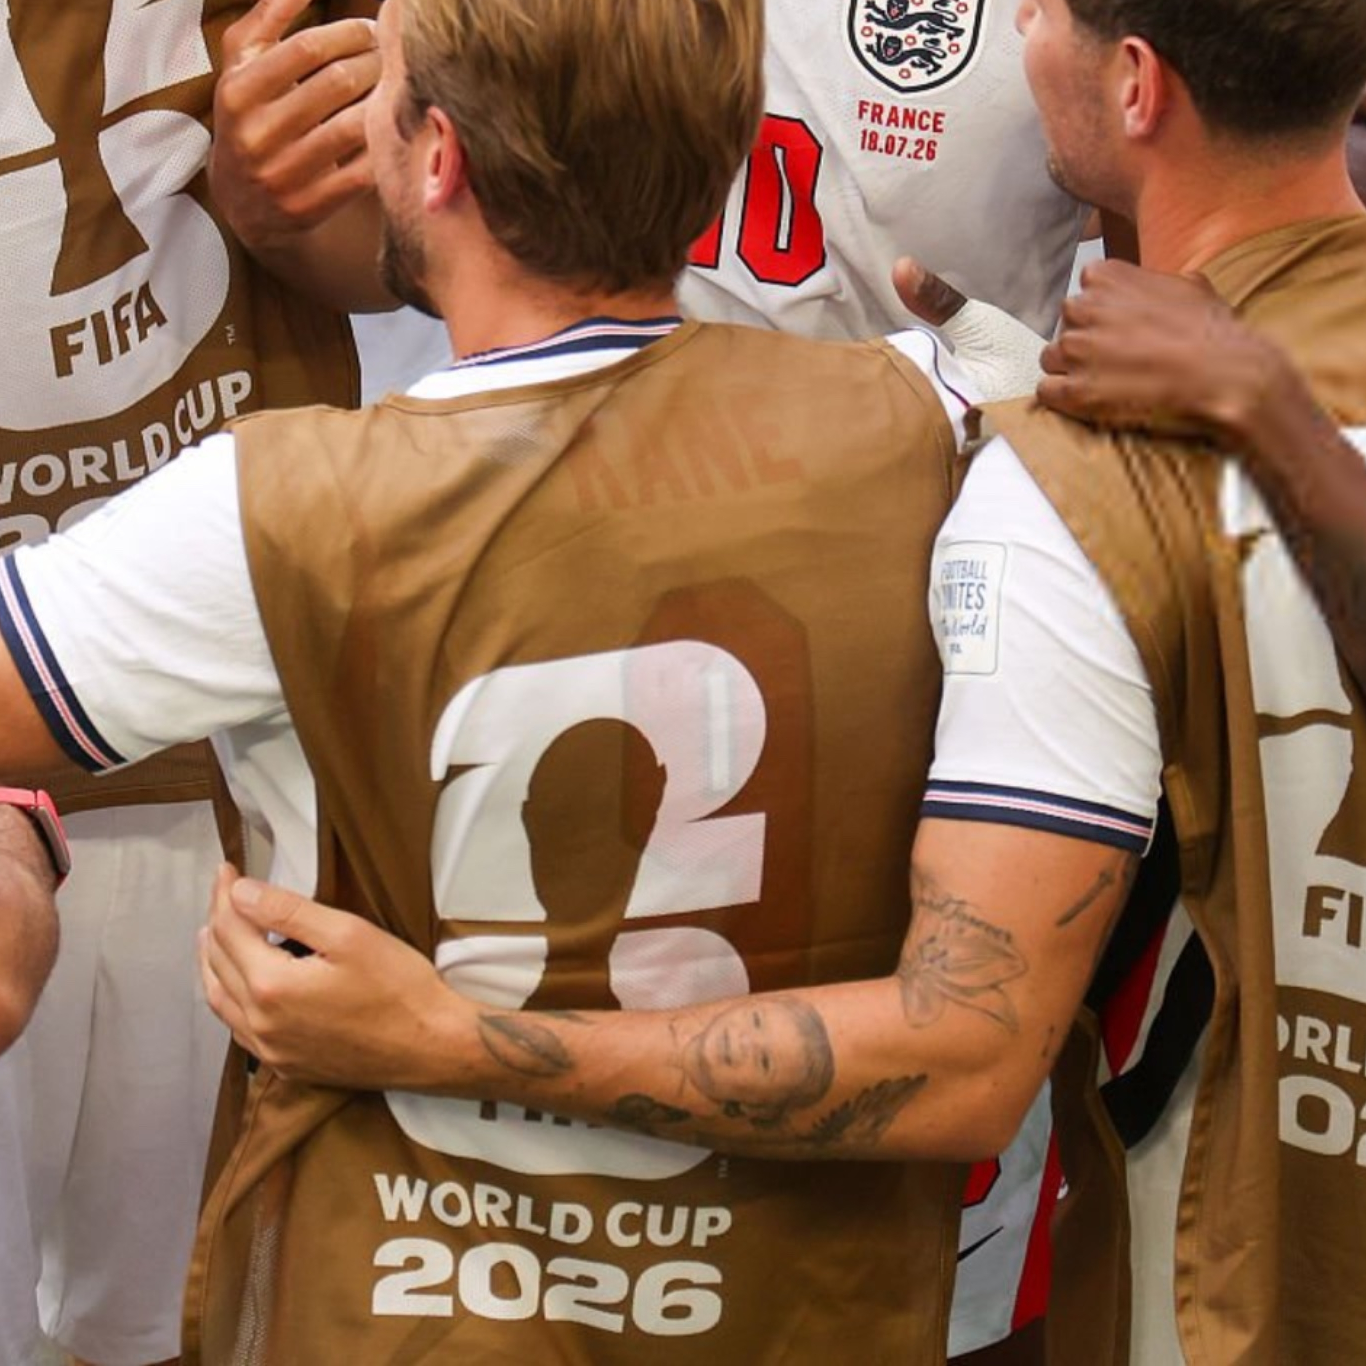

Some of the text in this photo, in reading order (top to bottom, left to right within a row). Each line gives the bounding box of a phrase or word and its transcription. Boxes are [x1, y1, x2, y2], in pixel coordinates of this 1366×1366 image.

[857, 100, 946, 134] FRANCE
[860, 128, 938, 162] 18.07.26
[50, 281, 168, 379] FIFA
[174, 371, 252, 446] CUP
[373, 1173, 732, 1247] WORLD CUP
[371, 1237, 723, 1335] 2026
